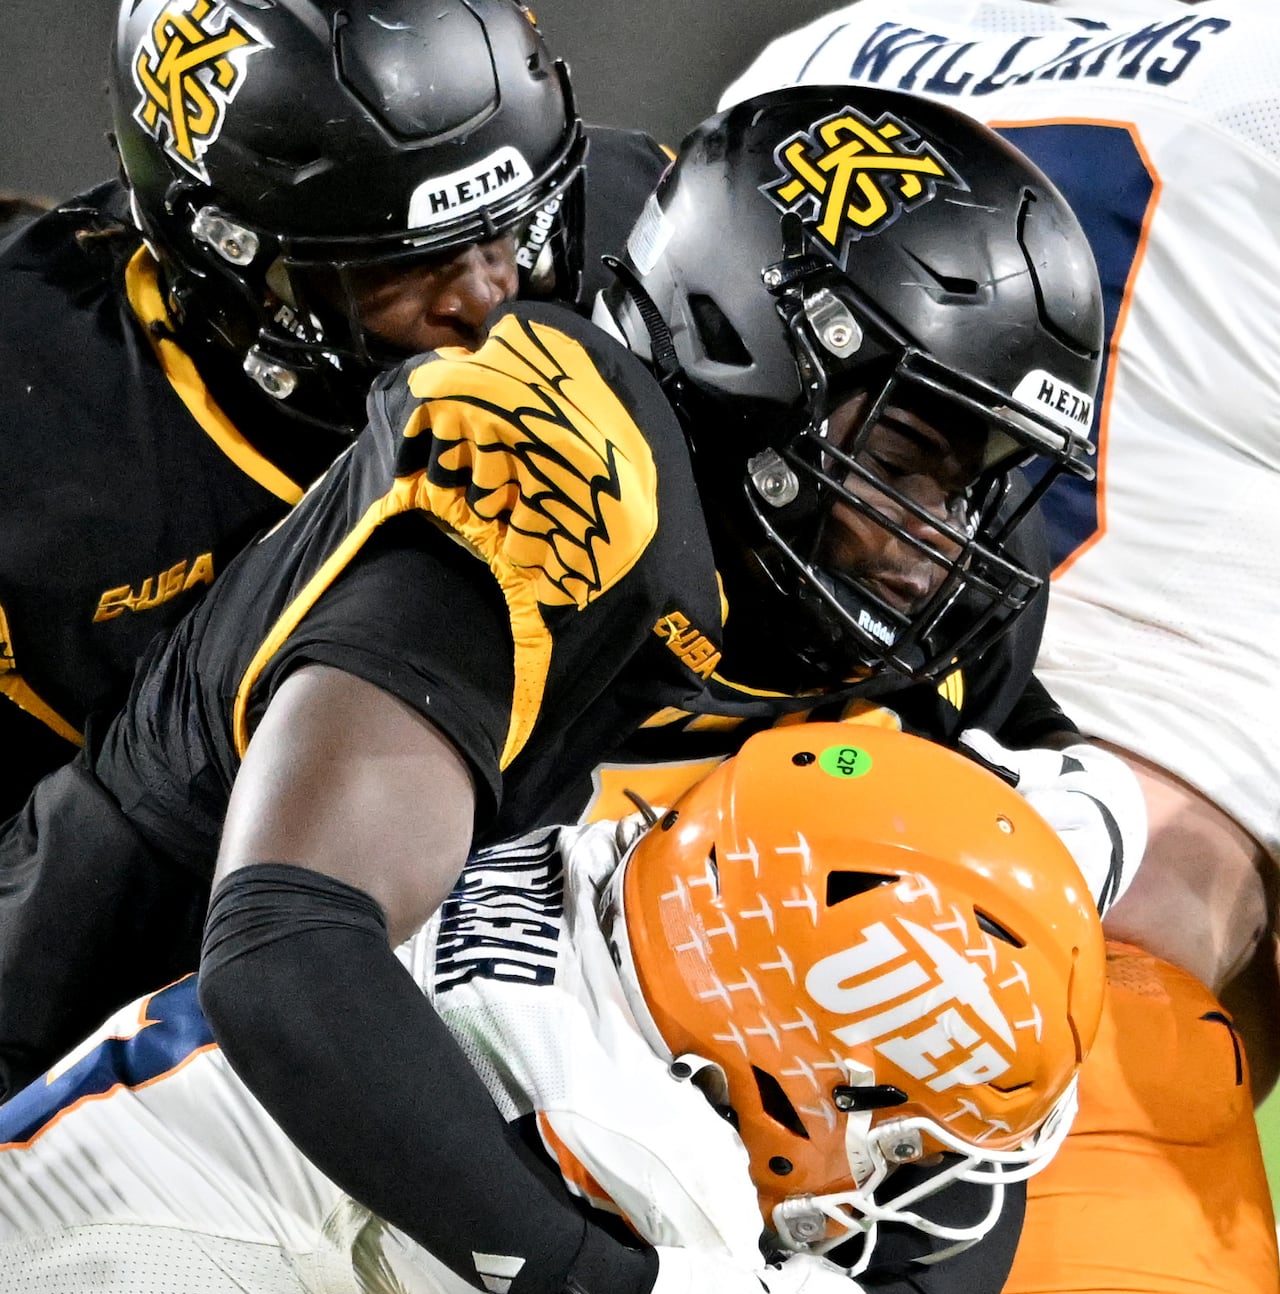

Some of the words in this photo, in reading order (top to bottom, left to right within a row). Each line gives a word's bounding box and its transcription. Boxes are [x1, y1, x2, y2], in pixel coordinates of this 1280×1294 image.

[428, 159, 521, 216] H.E.T.M.
[515, 192, 564, 270] Ridde
[836, 748, 858, 776] C2P
[433, 826, 565, 995] OCKLEAR
[804, 914, 1017, 1093] UTEP
